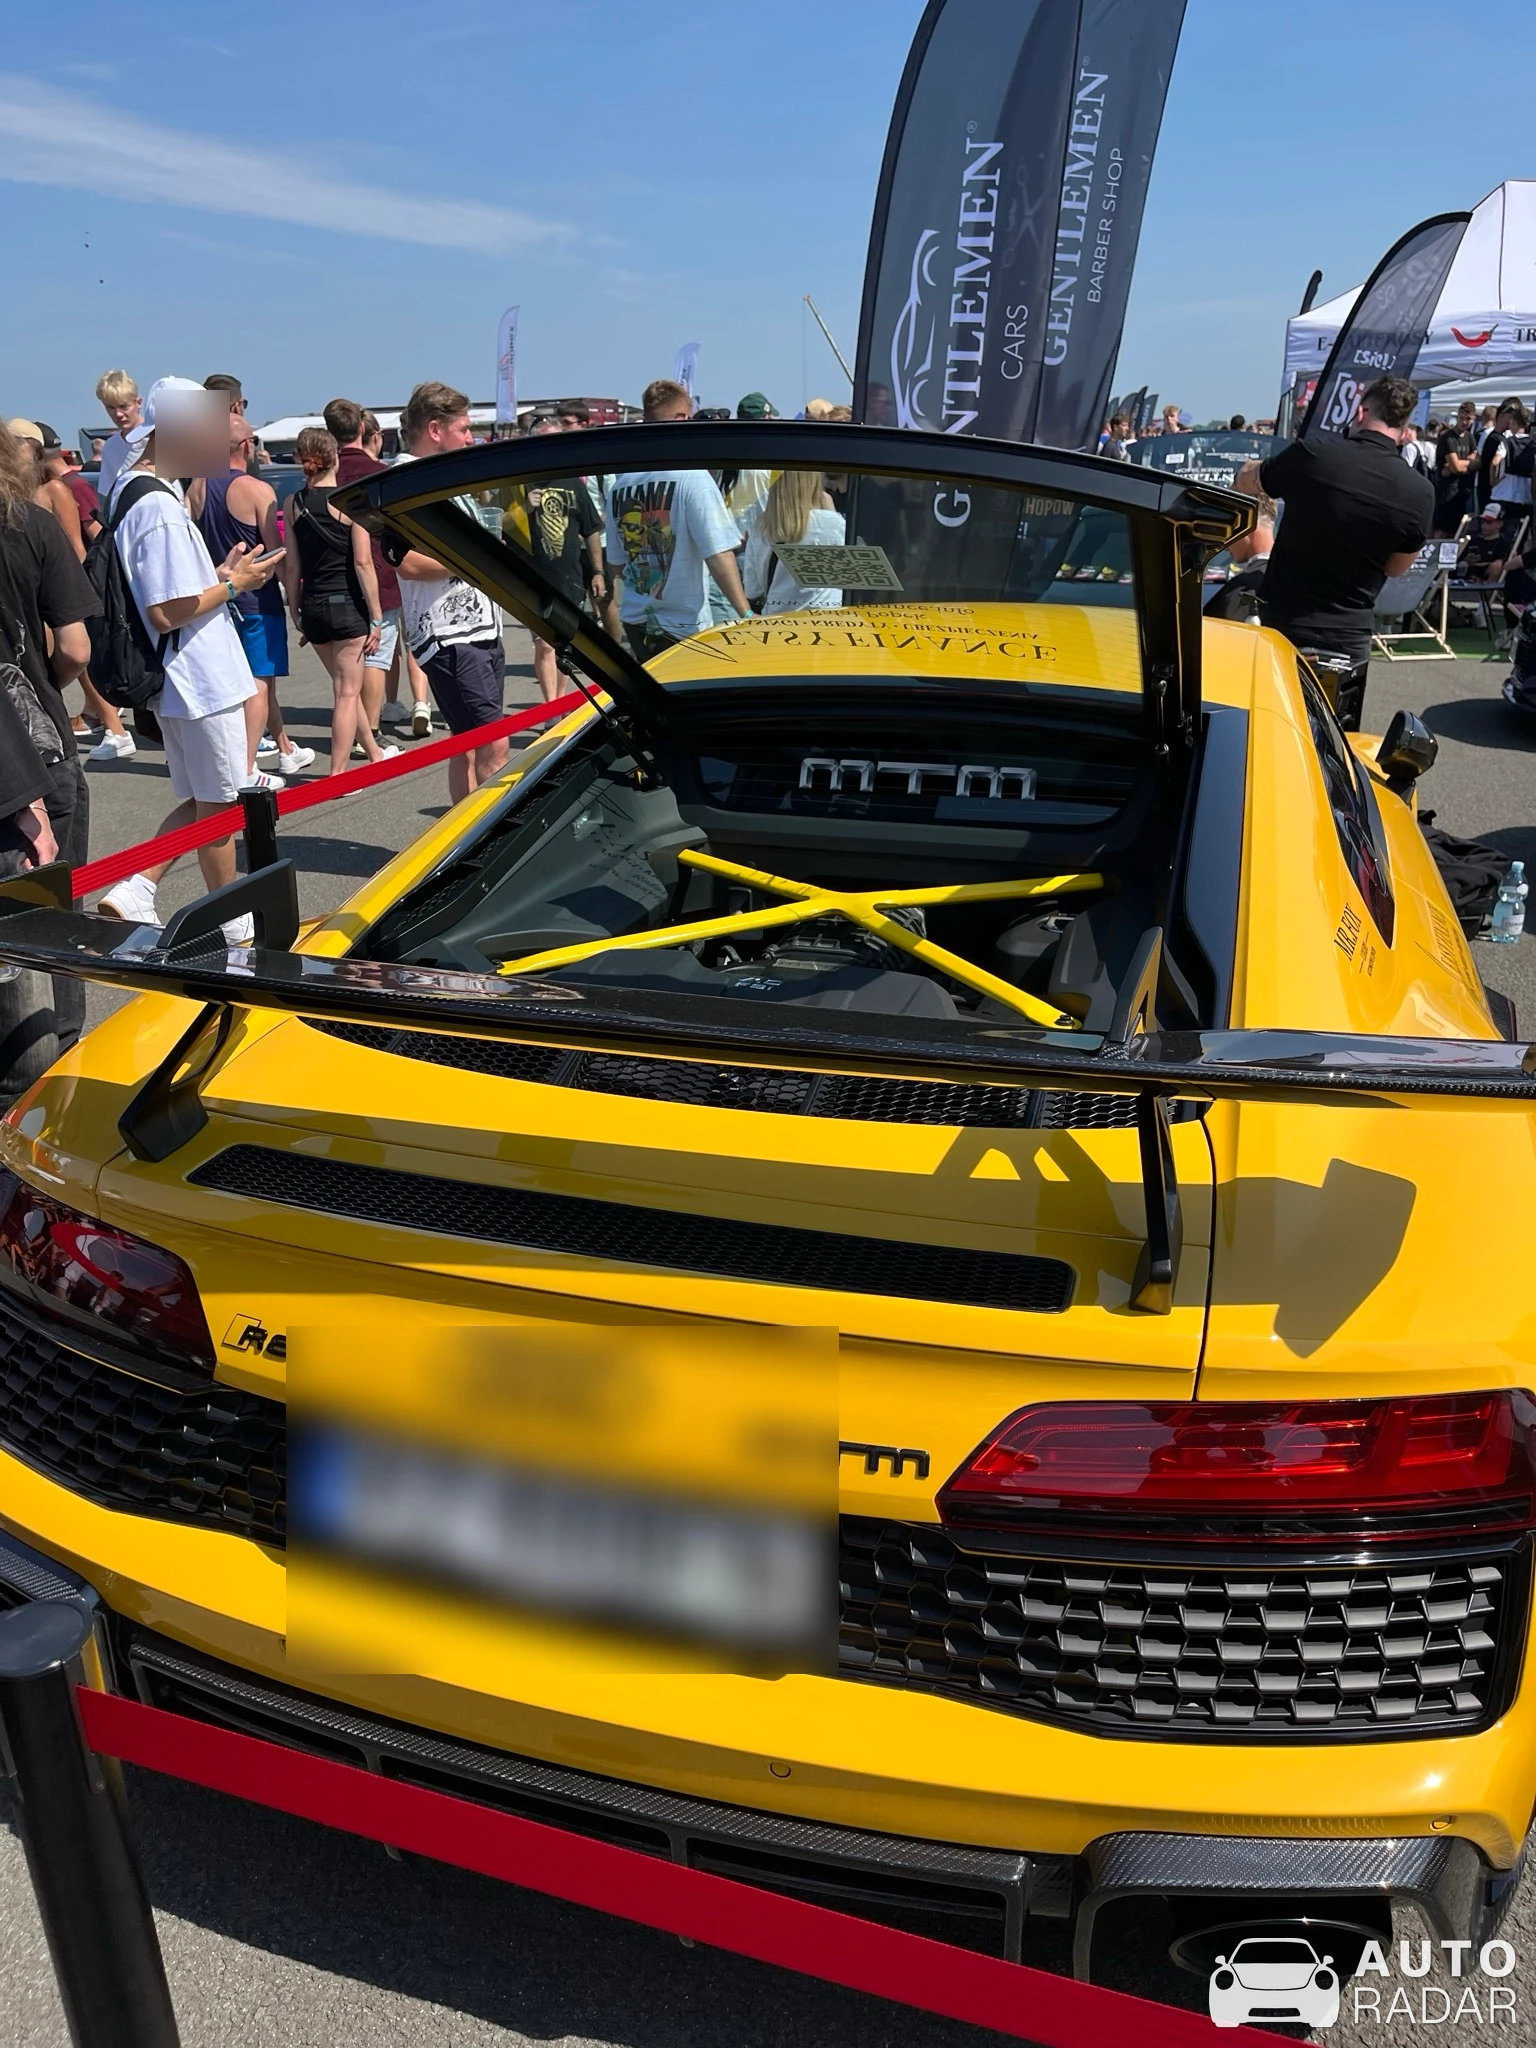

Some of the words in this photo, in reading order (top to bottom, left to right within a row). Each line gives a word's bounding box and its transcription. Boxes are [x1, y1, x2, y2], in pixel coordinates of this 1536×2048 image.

[1087, 218, 1113, 303] BARBER
[1102, 148, 1124, 212] SHOP
[1001, 304, 1029, 380] CARS
[612, 481, 676, 519] MIAMI
